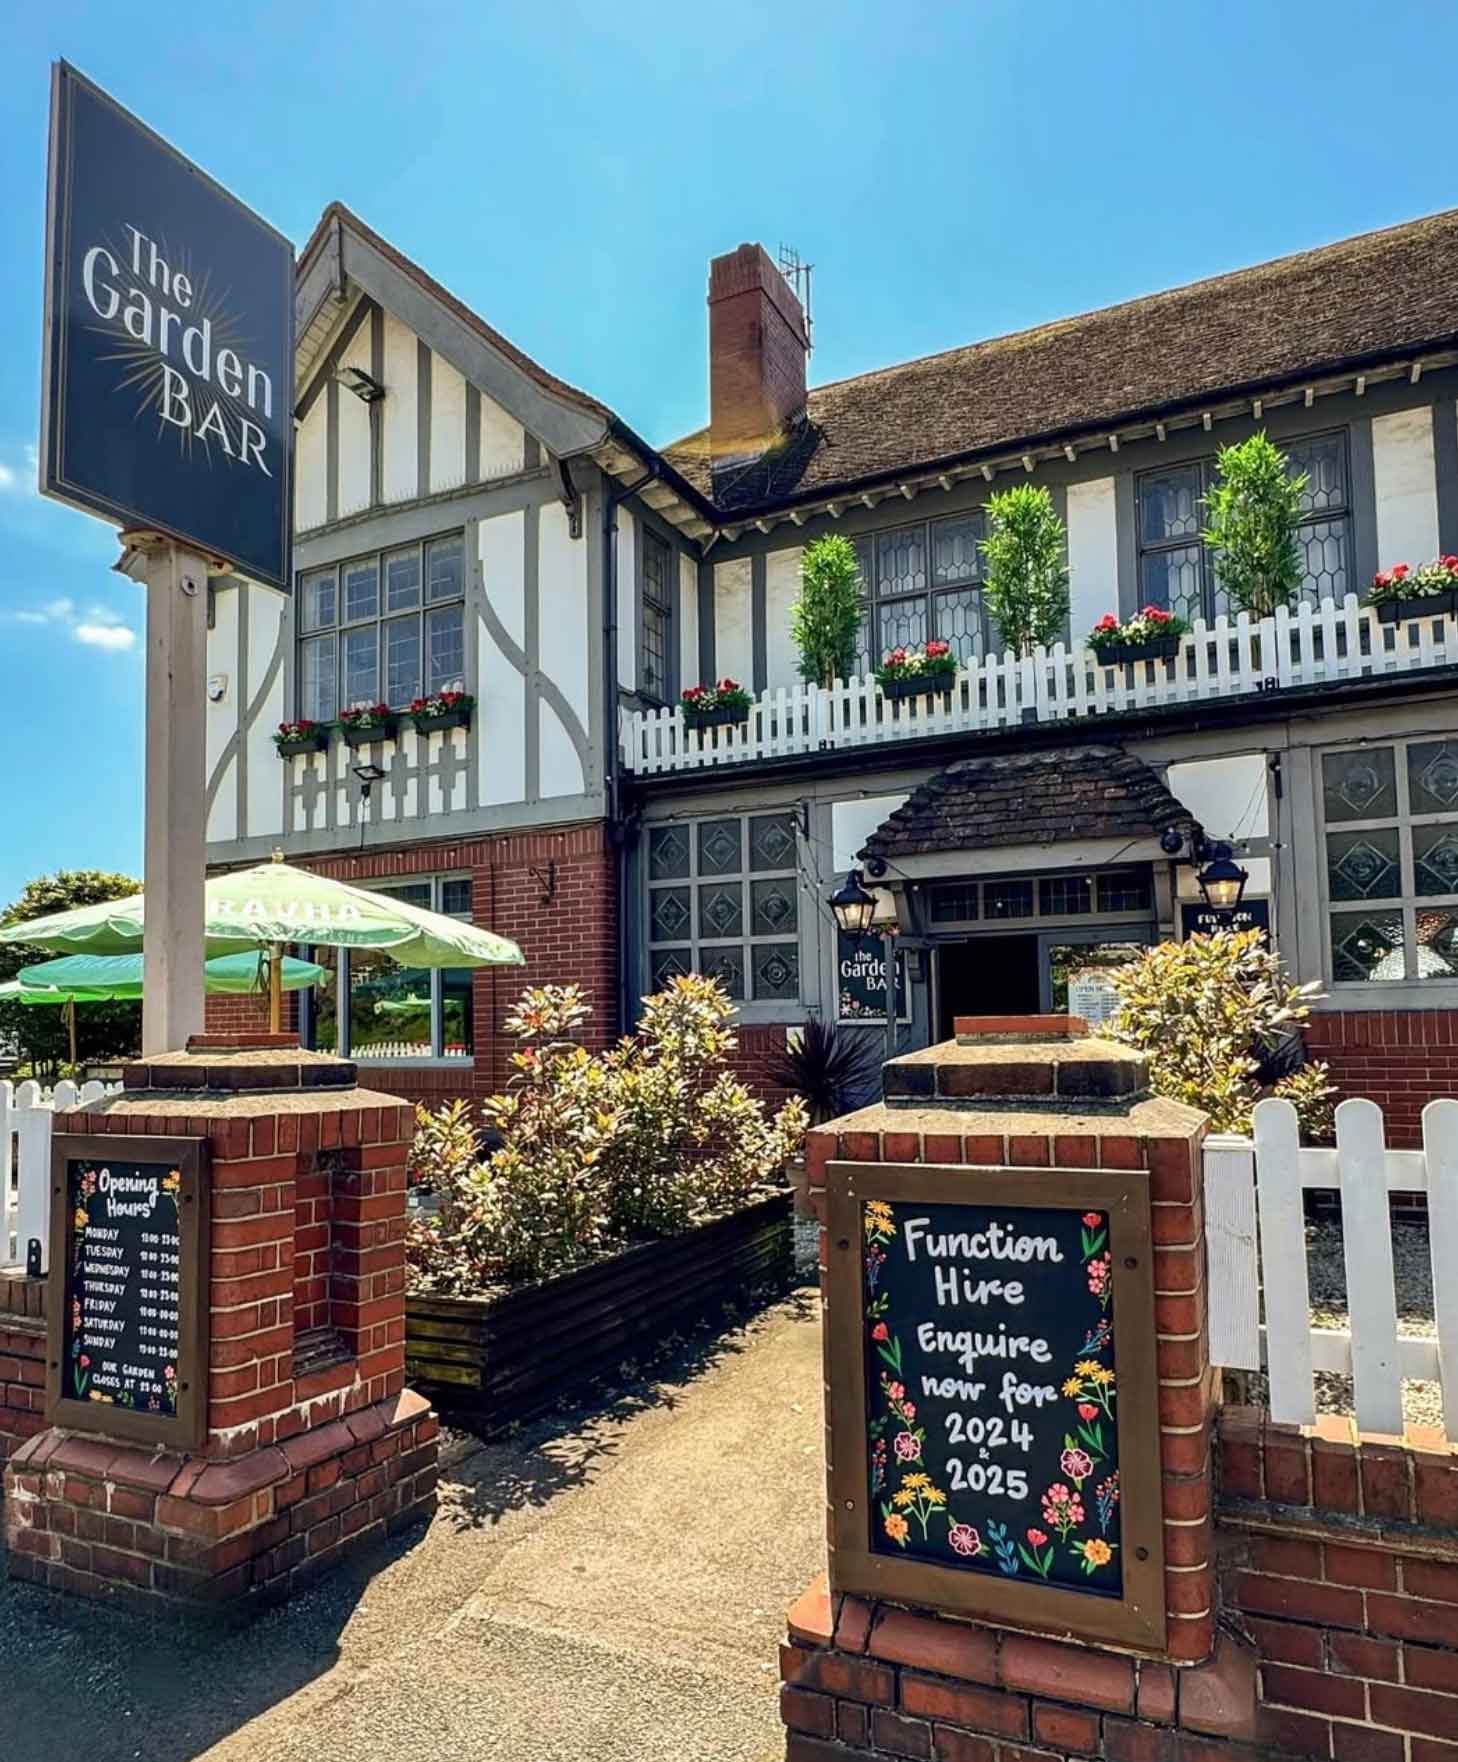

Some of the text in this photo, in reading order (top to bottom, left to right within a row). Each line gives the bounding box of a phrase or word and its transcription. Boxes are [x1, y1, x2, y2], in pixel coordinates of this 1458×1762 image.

[125, 223, 192, 307] The
[83, 247, 271, 418] Garden
[159, 362, 273, 478] BAR
[99, 1168, 159, 1208] Opening
[107, 1198, 151, 1218] Hours
[85, 1227, 119, 1241] MONDAY
[904, 1218, 1064, 1263] Function
[85, 1245, 124, 1260] TUESDAY
[83, 1280, 126, 1296] THURSDAY
[935, 1265, 1025, 1306] Hire
[84, 1298, 117, 1312] FRIDAY
[83, 1317, 125, 1332] SATURDAY
[83, 1334, 115, 1349] SUNDAY
[917, 1322, 1053, 1374] Enquire
[122, 1364, 155, 1379] GARDEN
[124, 1379, 136, 1389] AT
[921, 1371, 1059, 1413] now for
[945, 1412, 1034, 1453] 2024
[979, 1447, 991, 1460] &
[945, 1458, 1029, 1500] 2025
